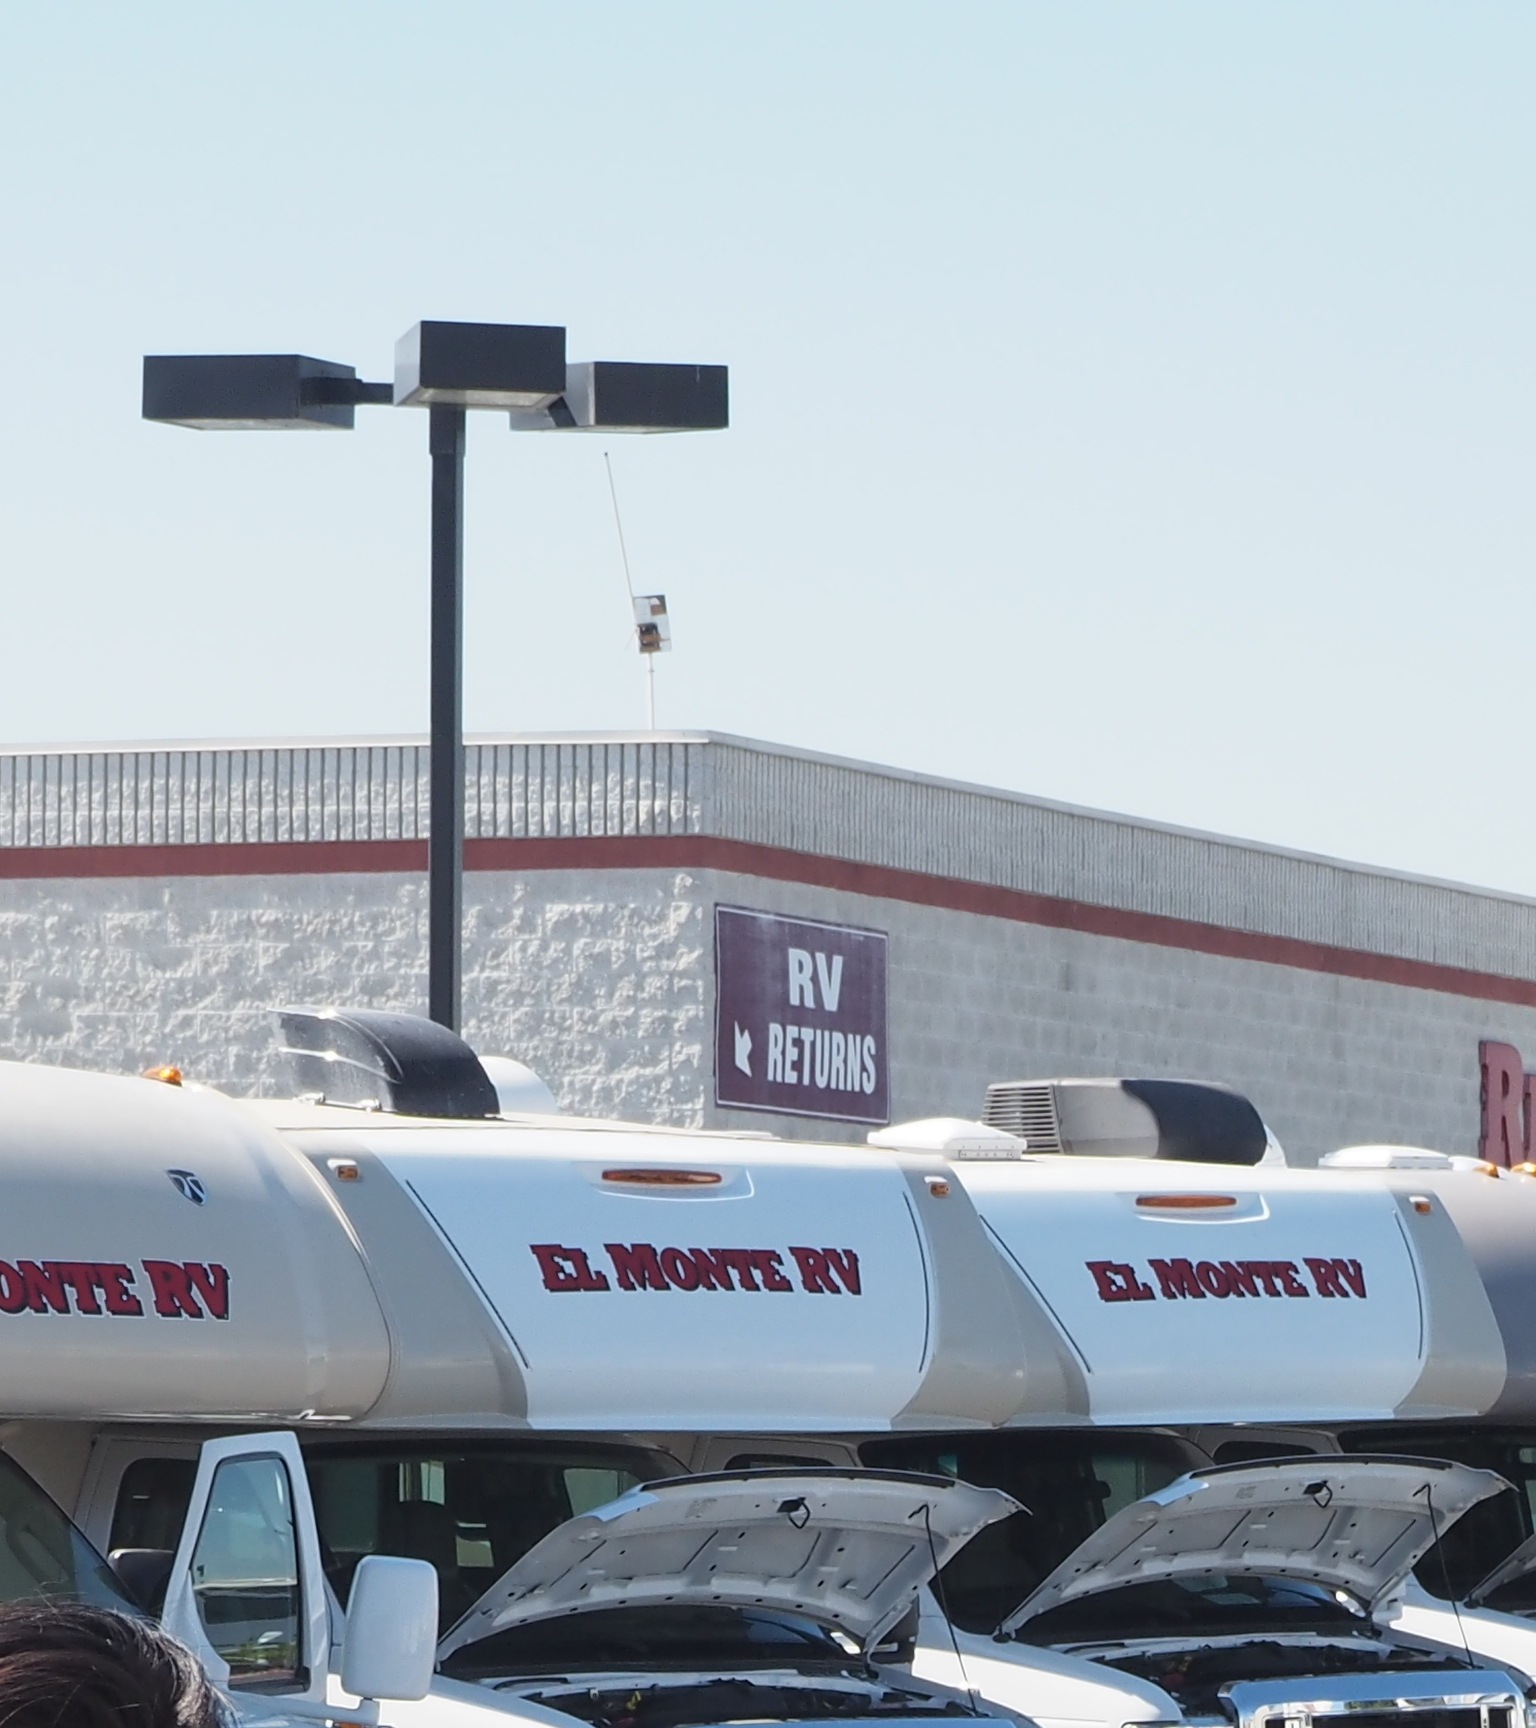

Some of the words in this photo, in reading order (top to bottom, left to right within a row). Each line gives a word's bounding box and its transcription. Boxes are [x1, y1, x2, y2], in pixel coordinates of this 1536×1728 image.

[788, 948, 844, 1012] RV
[767, 1022, 877, 1095] RETURNS
[140, 1258, 231, 1321] RV
[528, 1243, 611, 1292] EL
[603, 1243, 795, 1292] MONTE
[788, 1246, 863, 1296] RV
[1084, 1260, 1157, 1303] EL
[1146, 1258, 1311, 1300] MONTE
[1302, 1257, 1368, 1299] RV
